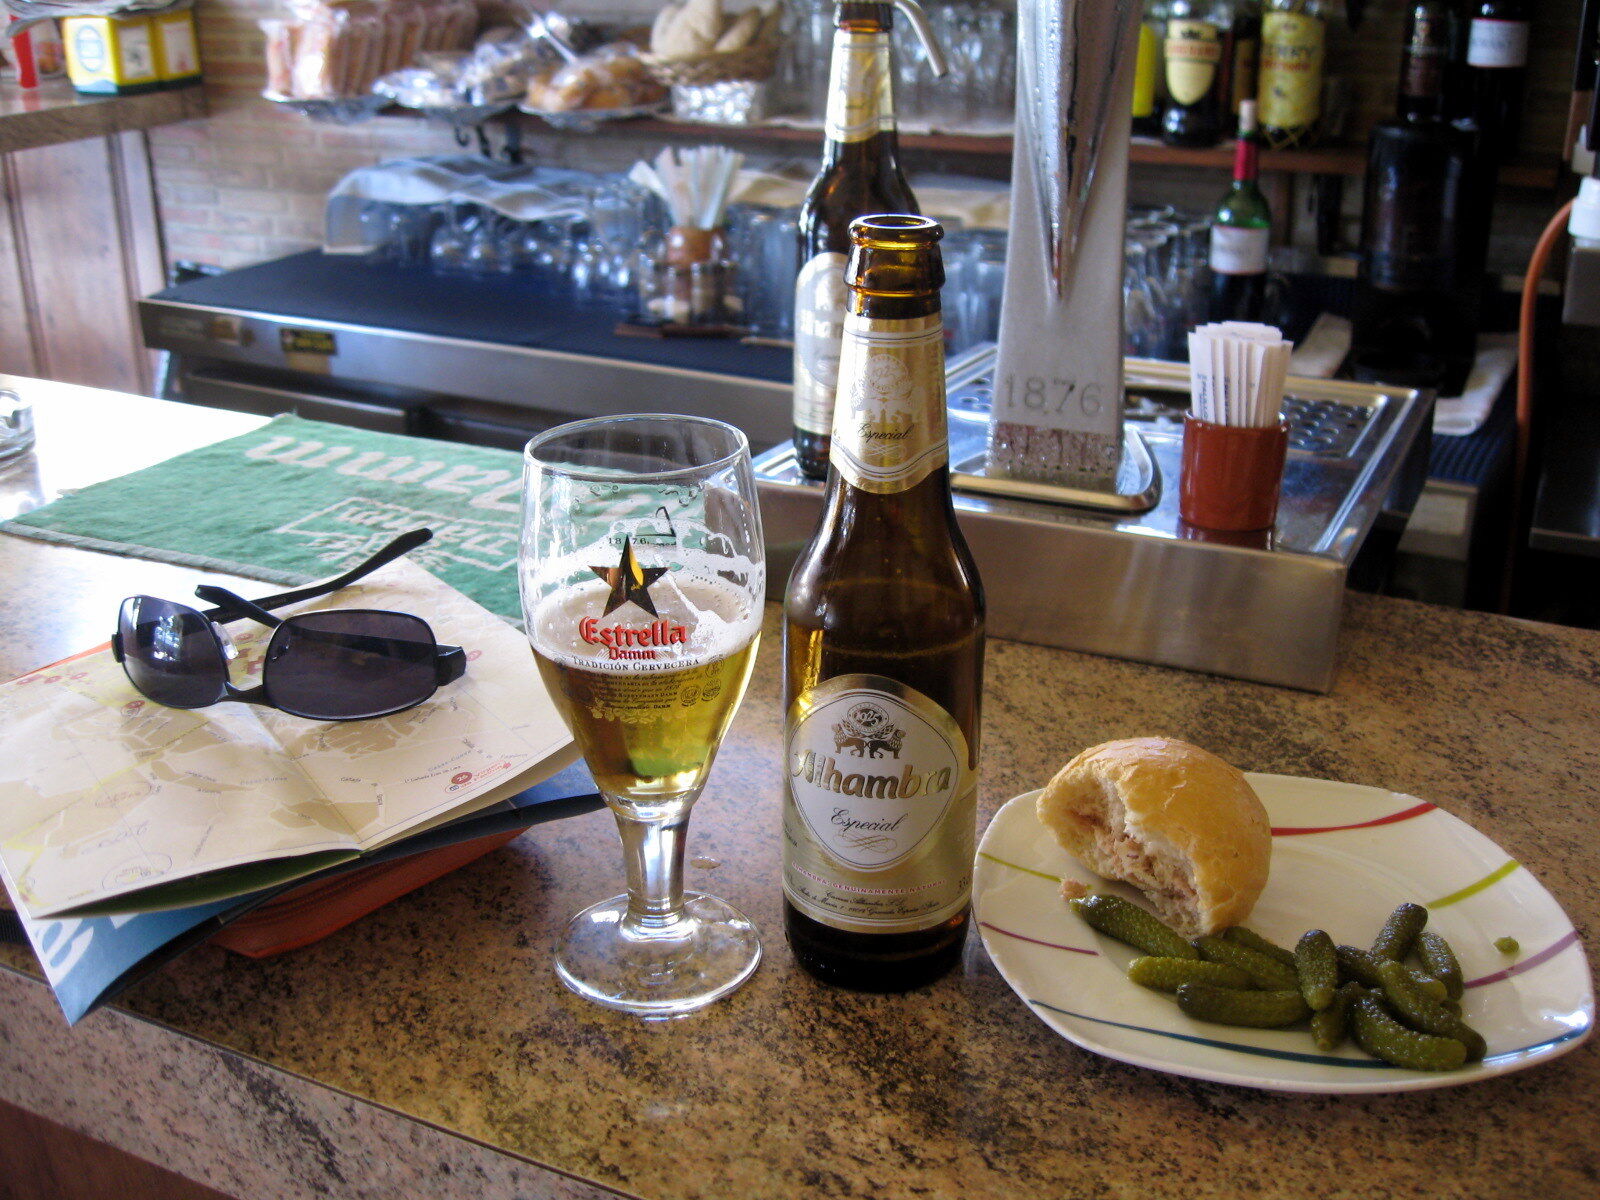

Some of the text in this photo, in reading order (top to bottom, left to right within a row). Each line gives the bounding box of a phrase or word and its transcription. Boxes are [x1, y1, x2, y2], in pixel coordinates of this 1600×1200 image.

[1006, 374, 1103, 417] 1876
[857, 423, 915, 443] Especial
[578, 615, 687, 647] Estrella
[609, 646, 656, 660] Damm
[791, 748, 952, 800] Alhambra
[830, 807, 909, 833] Especial
